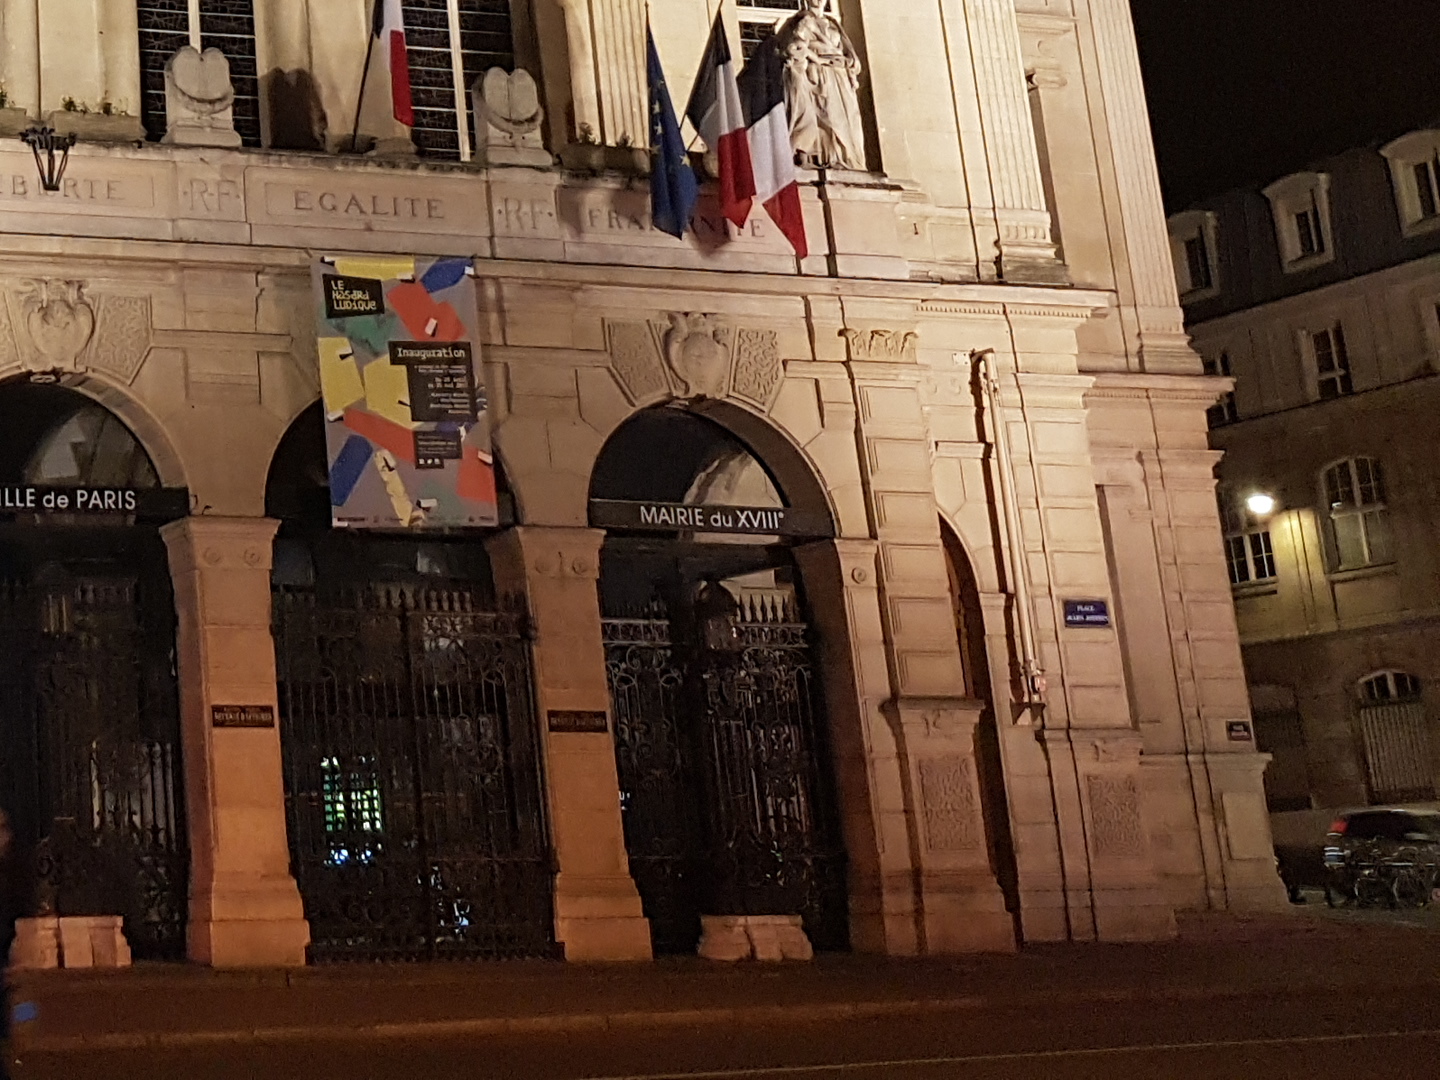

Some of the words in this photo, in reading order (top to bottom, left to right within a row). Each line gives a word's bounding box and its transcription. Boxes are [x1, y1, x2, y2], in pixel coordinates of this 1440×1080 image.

[293, 190, 446, 220] EGALITE
[330, 280, 345, 290] LE
[397, 346, 466, 360] Inauguration
[42, 490, 69, 508] de
[76, 489, 136, 510] PARIS
[640, 505, 705, 527] MAIRIE
[710, 511, 733, 528] du
